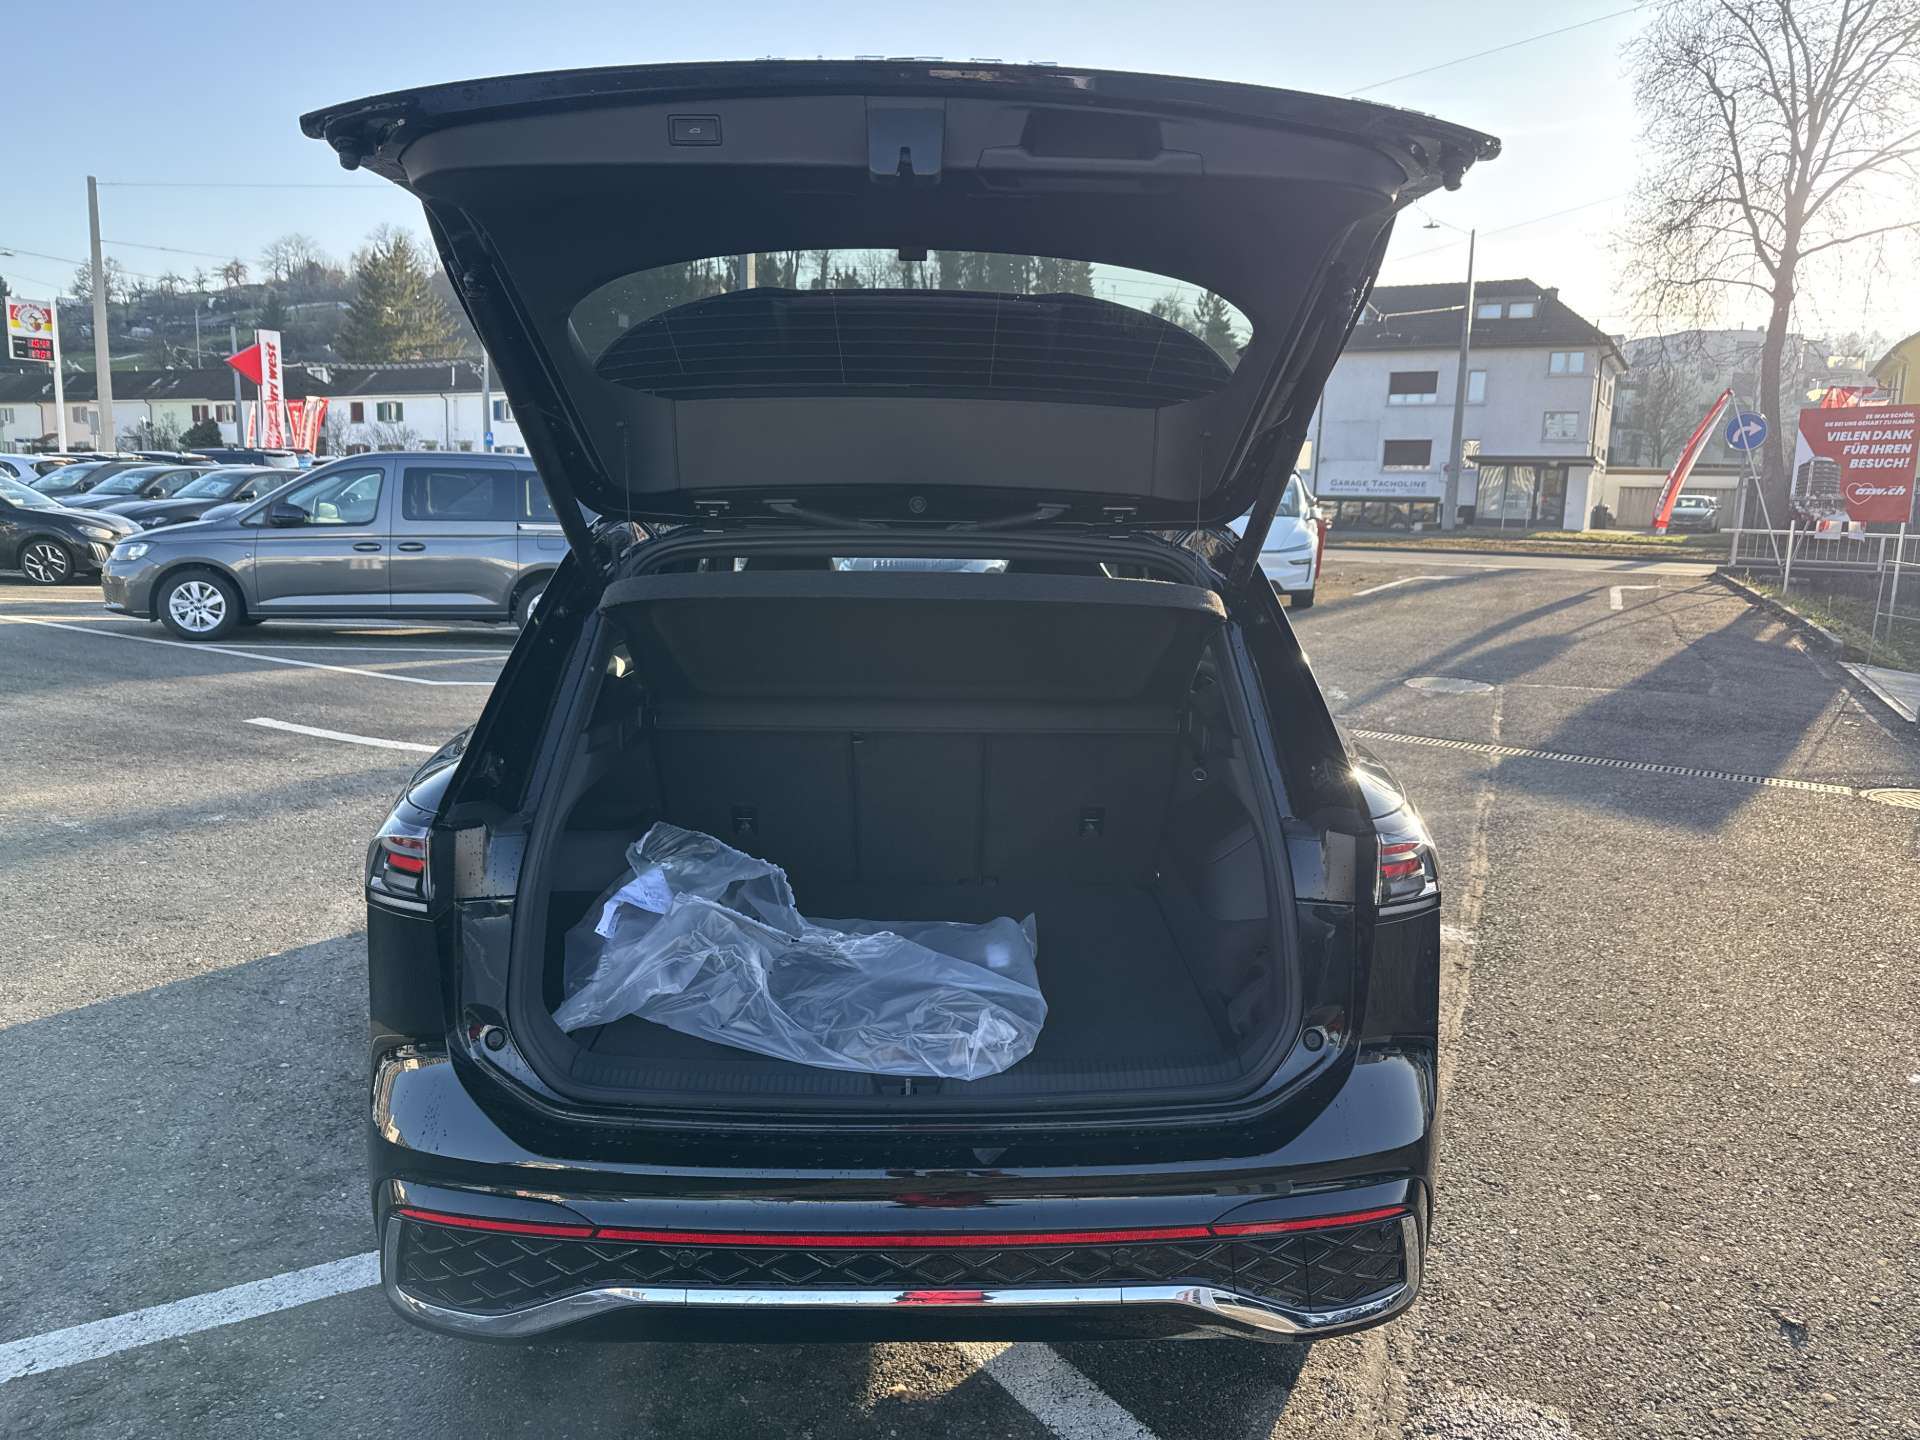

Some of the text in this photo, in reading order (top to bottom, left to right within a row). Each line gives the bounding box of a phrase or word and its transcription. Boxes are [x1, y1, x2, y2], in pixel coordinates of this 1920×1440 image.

[266, 342, 278, 380] west
[1857, 419, 1882, 427] GEHABT
[1827, 429, 1914, 442] VIELEN DANK
[1842, 442, 1912, 455] FÜR IHREN
[1849, 457, 1909, 469] BESUCH!
